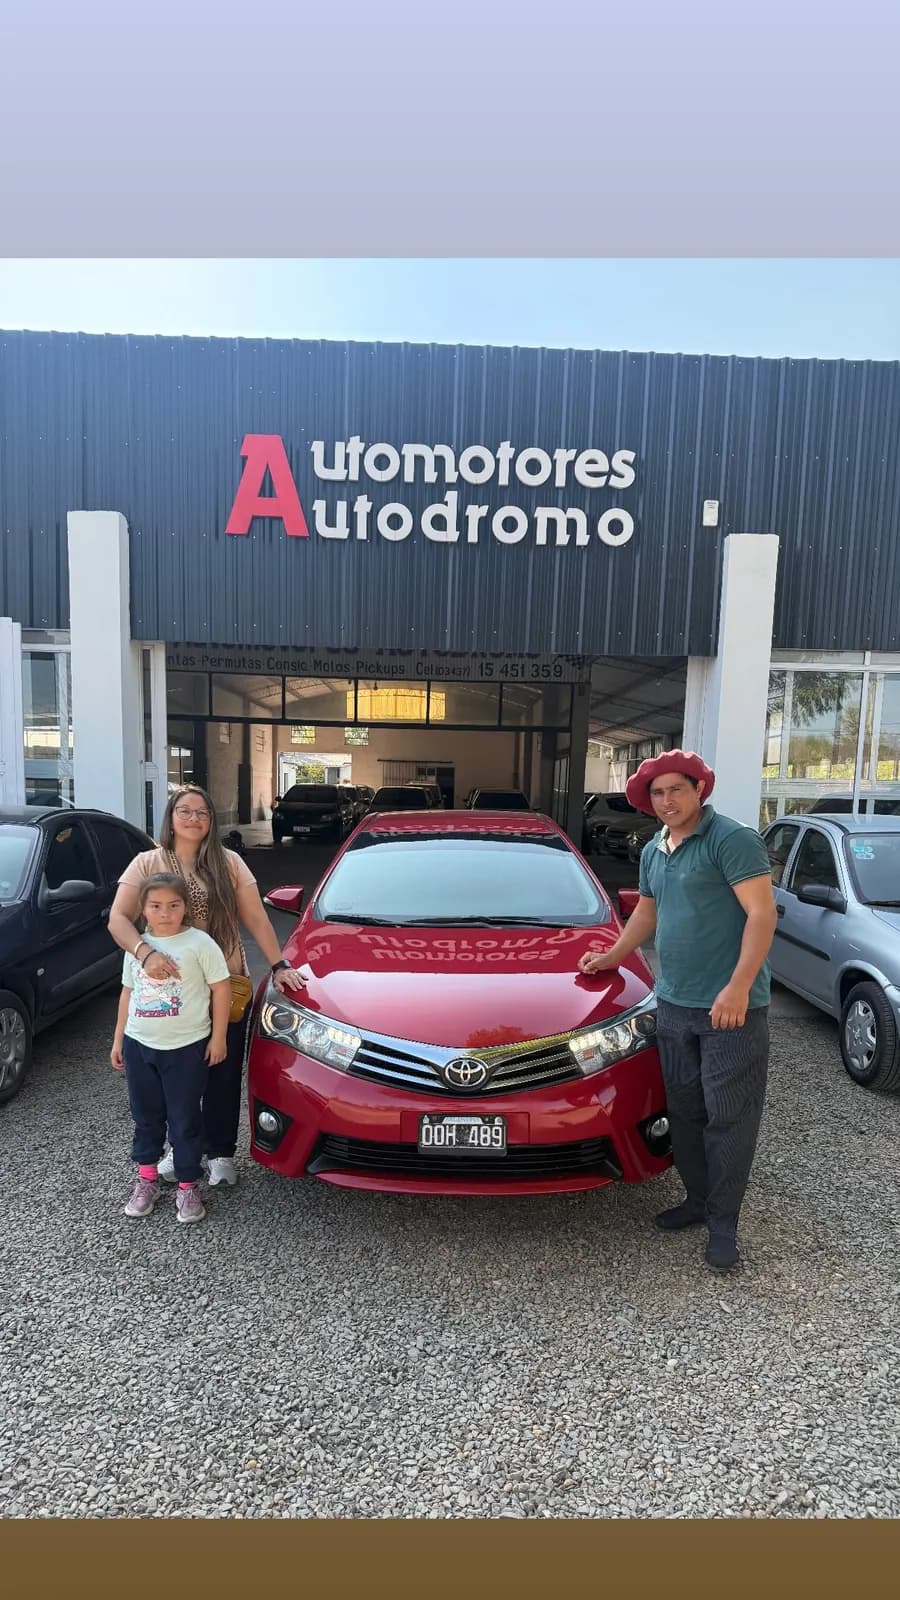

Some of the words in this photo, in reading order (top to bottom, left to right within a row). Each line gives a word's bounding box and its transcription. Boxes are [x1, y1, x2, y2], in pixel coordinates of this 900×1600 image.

[479, 663, 494, 677] 15
[500, 664, 526, 677] 451
[531, 664, 563, 678] 359
[468, 1125, 503, 1147] 489
